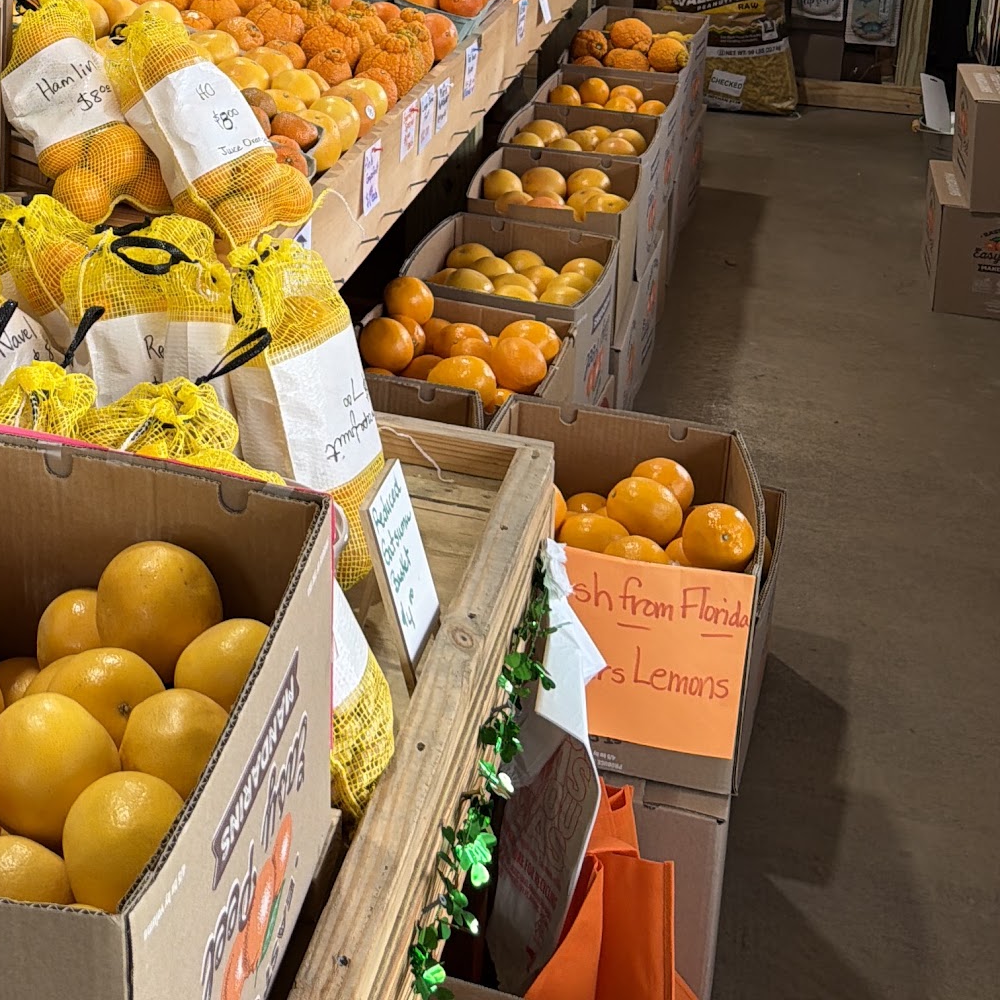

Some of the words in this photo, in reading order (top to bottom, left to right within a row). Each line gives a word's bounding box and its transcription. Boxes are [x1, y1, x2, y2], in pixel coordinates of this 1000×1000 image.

[737, 1, 759, 11] RAW
[710, 76, 743, 90] CHECKED
[218, 144, 244, 157] Juice
[373, 473, 403, 531] Reduced
[389, 547, 412, 592] Basket
[618, 575, 676, 623] from
[679, 585, 750, 629] Florida
[632, 645, 731, 700] Lemons
[220, 687, 300, 861] MANDARINS
[261, 711, 308, 851] Easy
